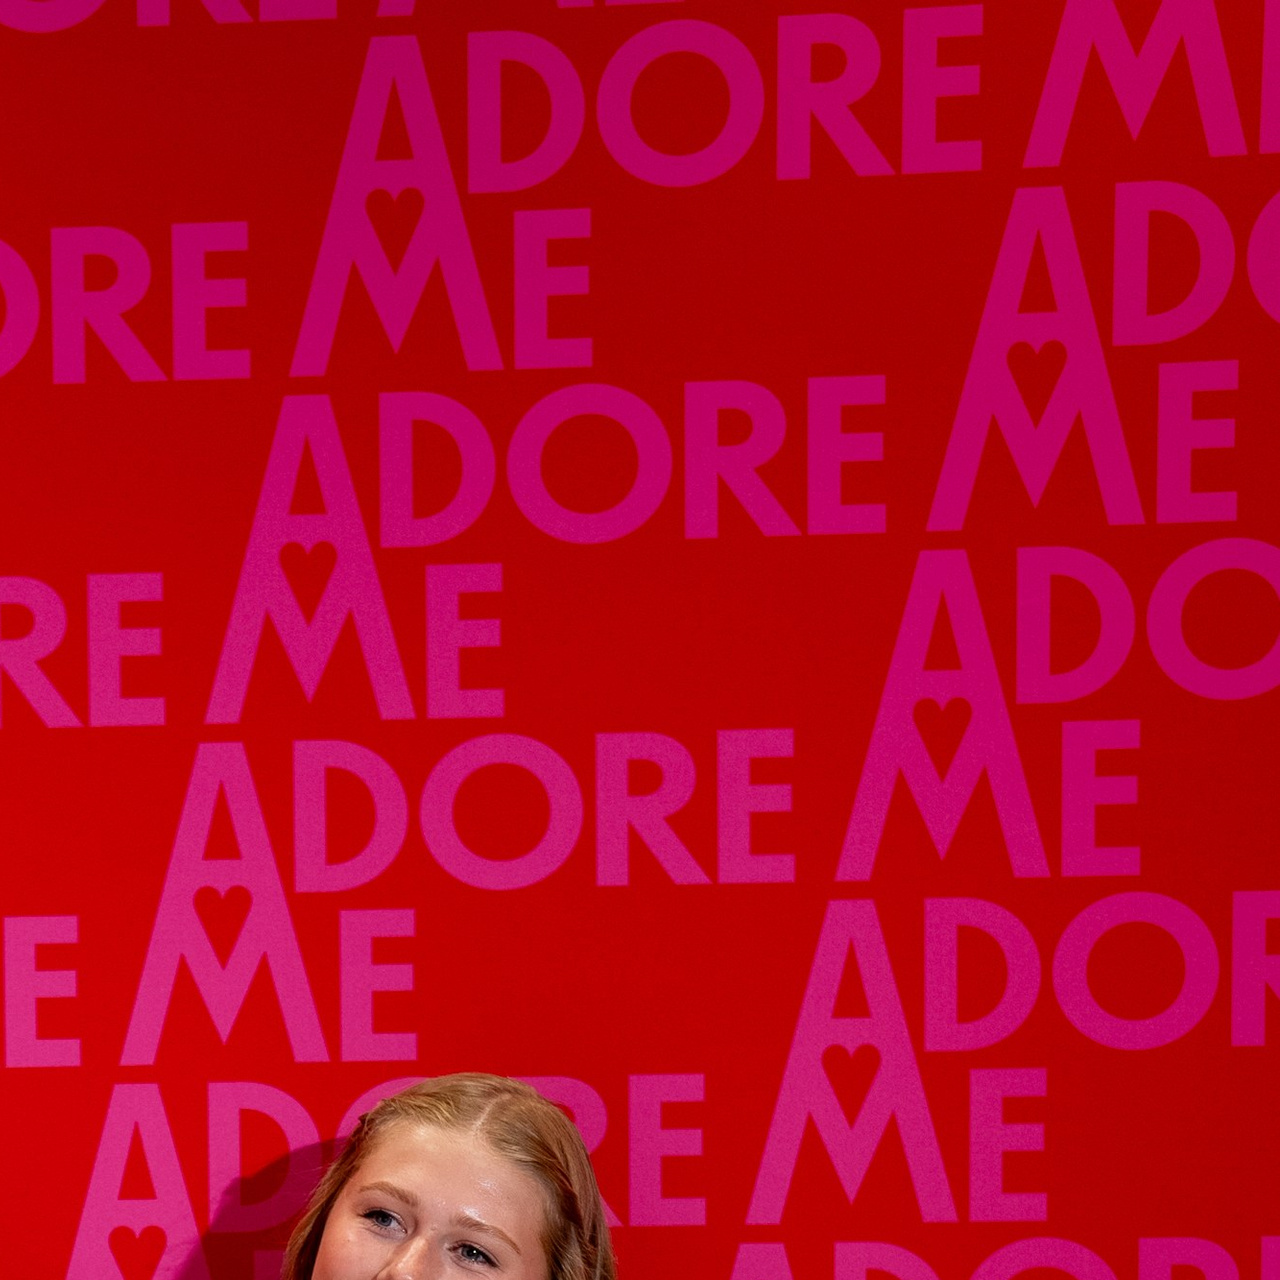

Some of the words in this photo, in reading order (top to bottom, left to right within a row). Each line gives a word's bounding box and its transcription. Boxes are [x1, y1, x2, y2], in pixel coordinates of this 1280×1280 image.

[333, 4, 983, 193] ADORE
[1024, 0, 1280, 167] M
[290, 185, 593, 377] ME
[246, 375, 886, 548] ADORE
[927, 338, 1239, 531] ME
[204, 540, 505, 724] ME
[880, 538, 1280, 704] ADO
[161, 728, 796, 893] ADORE
[835, 696, 1141, 881] ME
[119, 885, 418, 1066] ME
[745, 1044, 1047, 1225] ME
